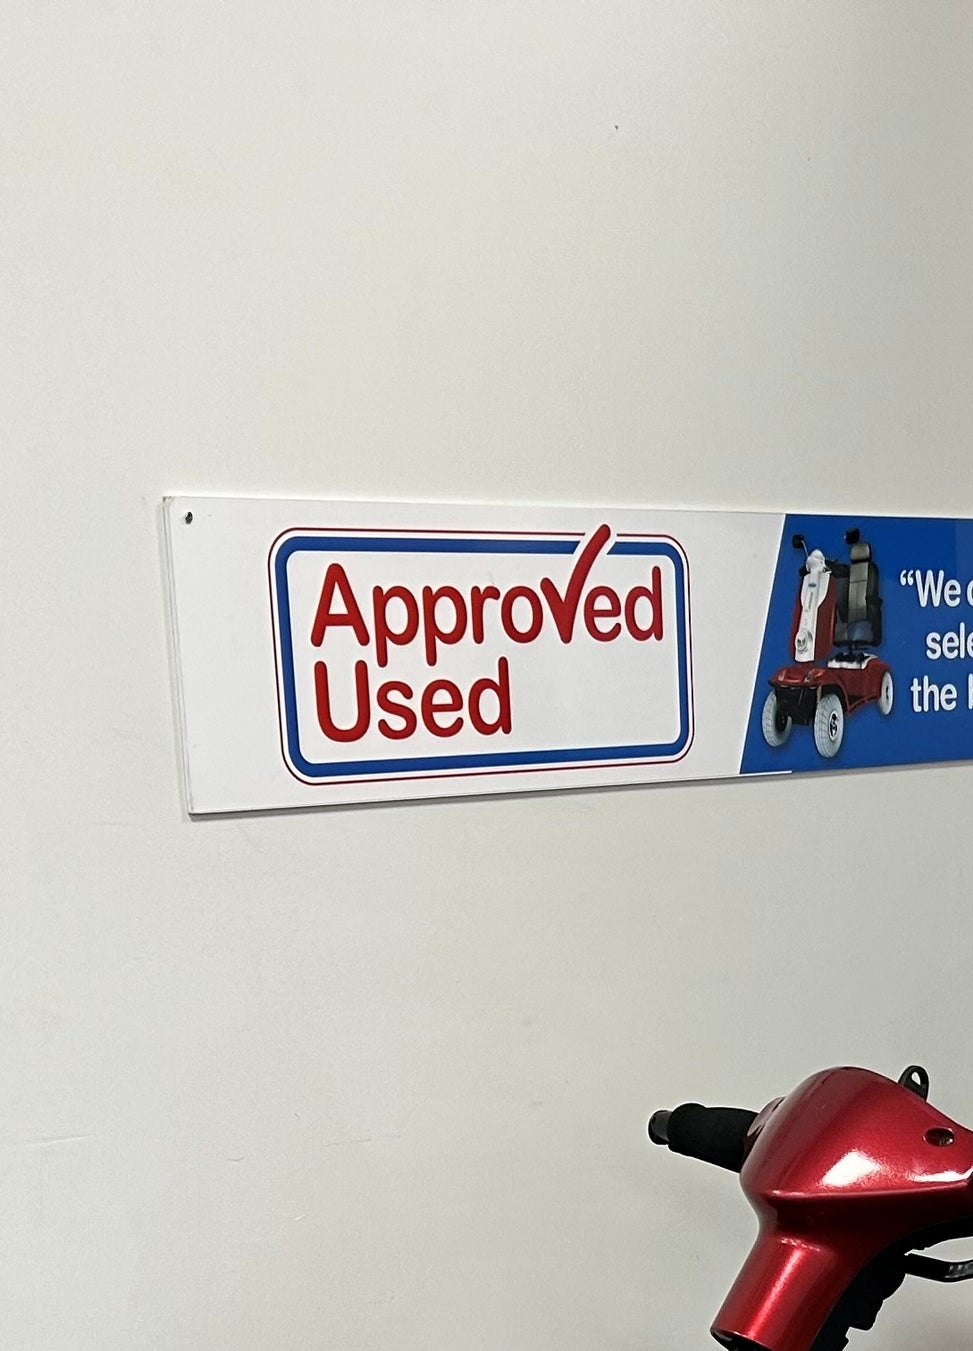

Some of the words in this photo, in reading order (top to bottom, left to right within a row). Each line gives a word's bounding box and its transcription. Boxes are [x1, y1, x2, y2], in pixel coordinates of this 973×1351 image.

[310, 525, 664, 668] Approved
[314, 656, 512, 743] Used
[910, 675, 958, 713] the
